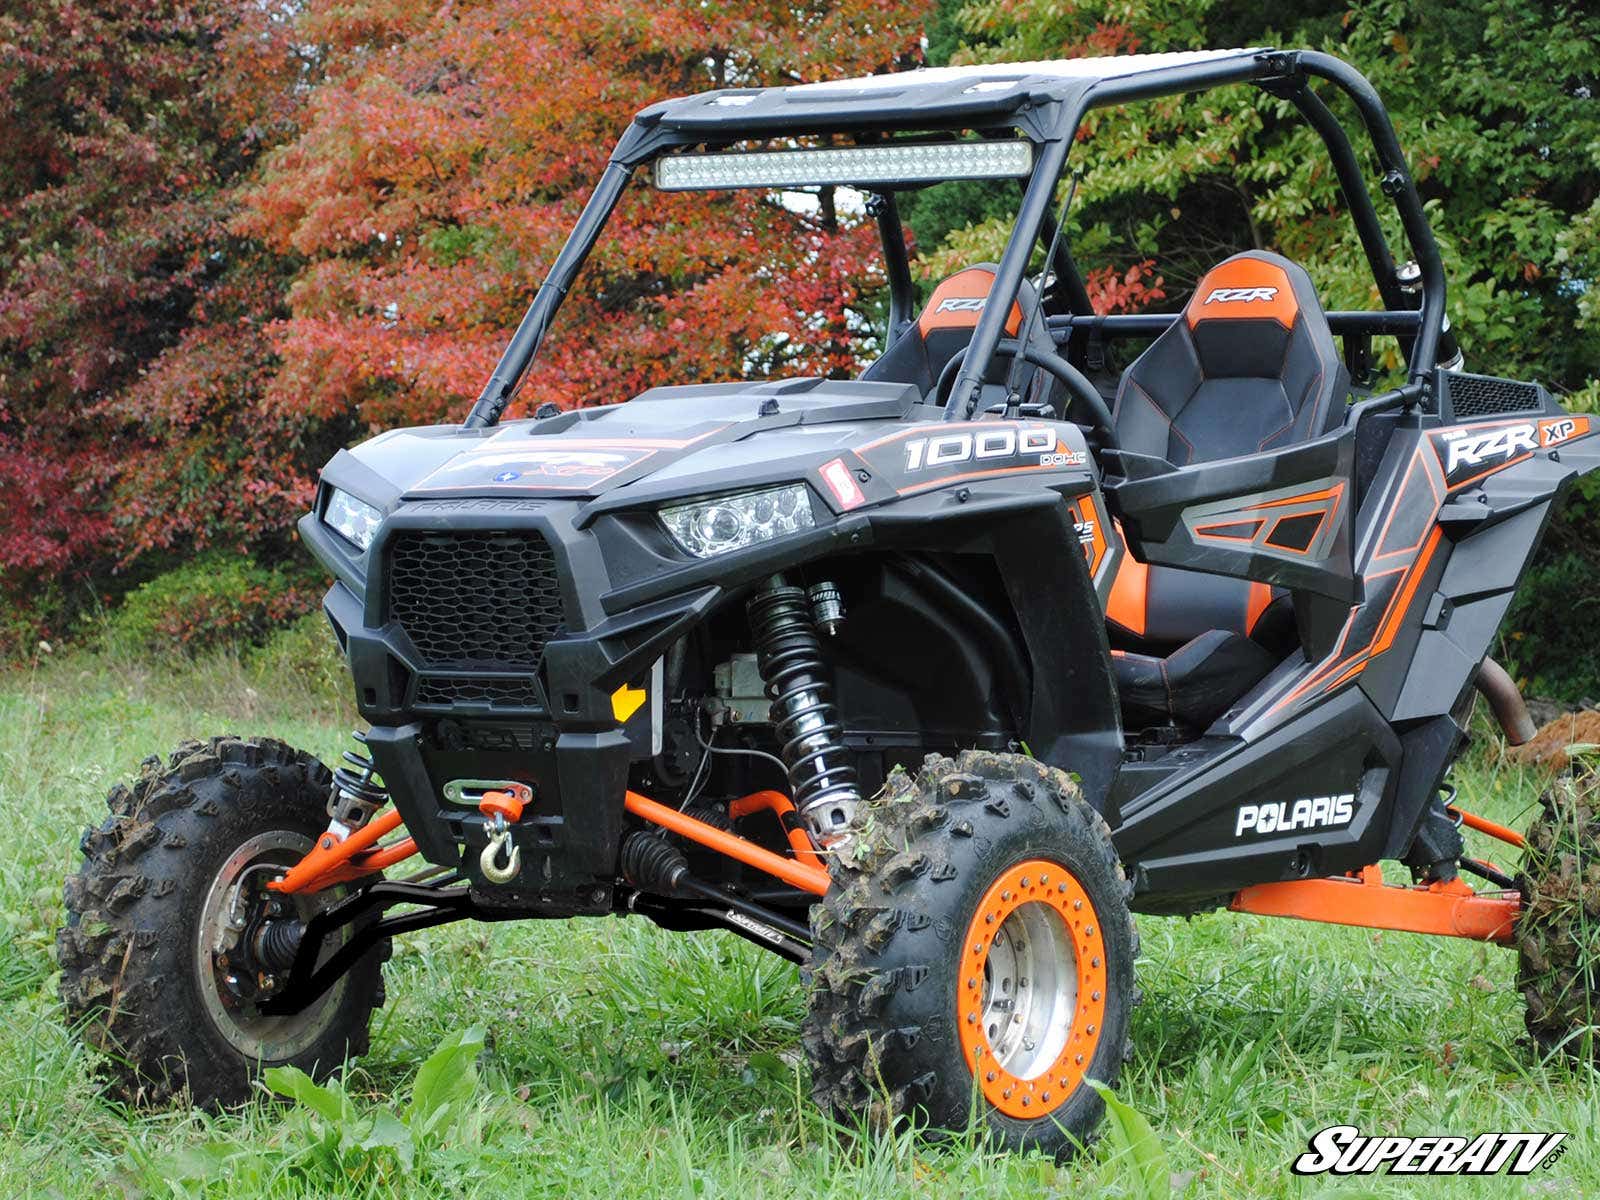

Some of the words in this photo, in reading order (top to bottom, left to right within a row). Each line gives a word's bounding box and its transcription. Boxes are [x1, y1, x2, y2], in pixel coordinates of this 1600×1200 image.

[1203, 283, 1279, 305] RZR
[904, 428, 1057, 473] 1000
[1040, 451, 1087, 466] DOHC
[1447, 424, 1539, 474] RZR
[1543, 420, 1576, 445] XP
[1235, 794, 1355, 837] POLARIS
